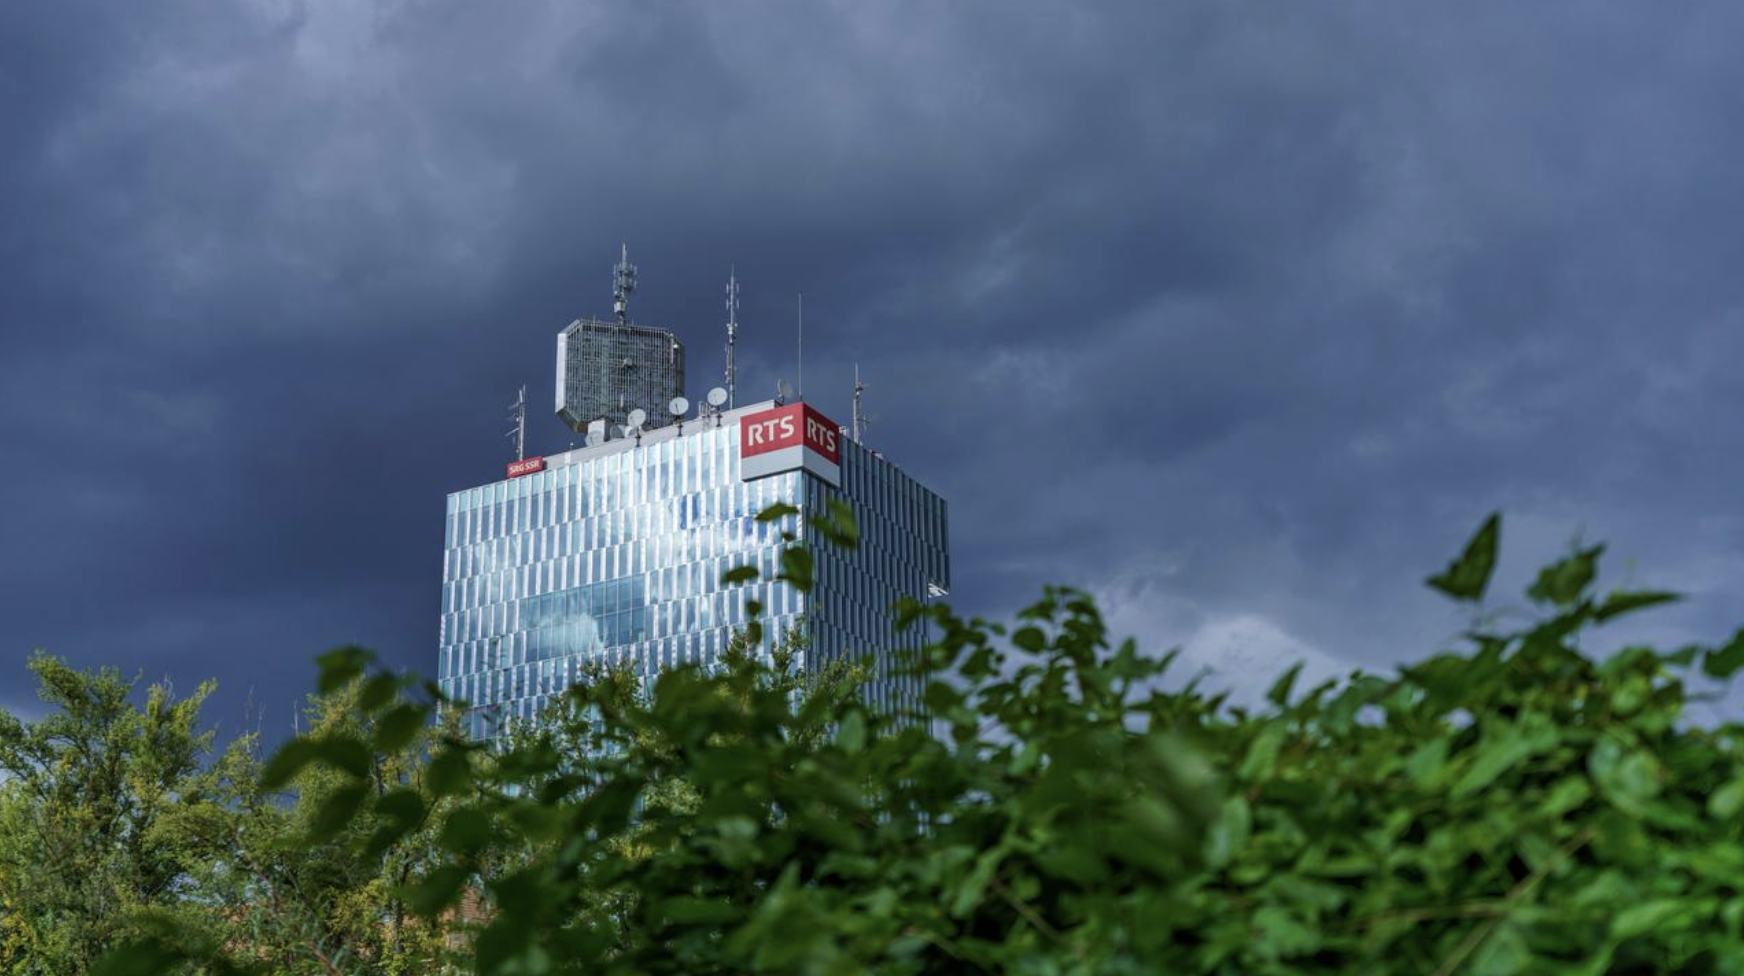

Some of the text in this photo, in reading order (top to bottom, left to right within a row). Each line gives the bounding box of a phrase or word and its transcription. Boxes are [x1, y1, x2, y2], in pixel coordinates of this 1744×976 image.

[748, 415, 795, 446] RTS
[807, 417, 836, 453] RTS
[509, 460, 540, 475] SRG SSR
